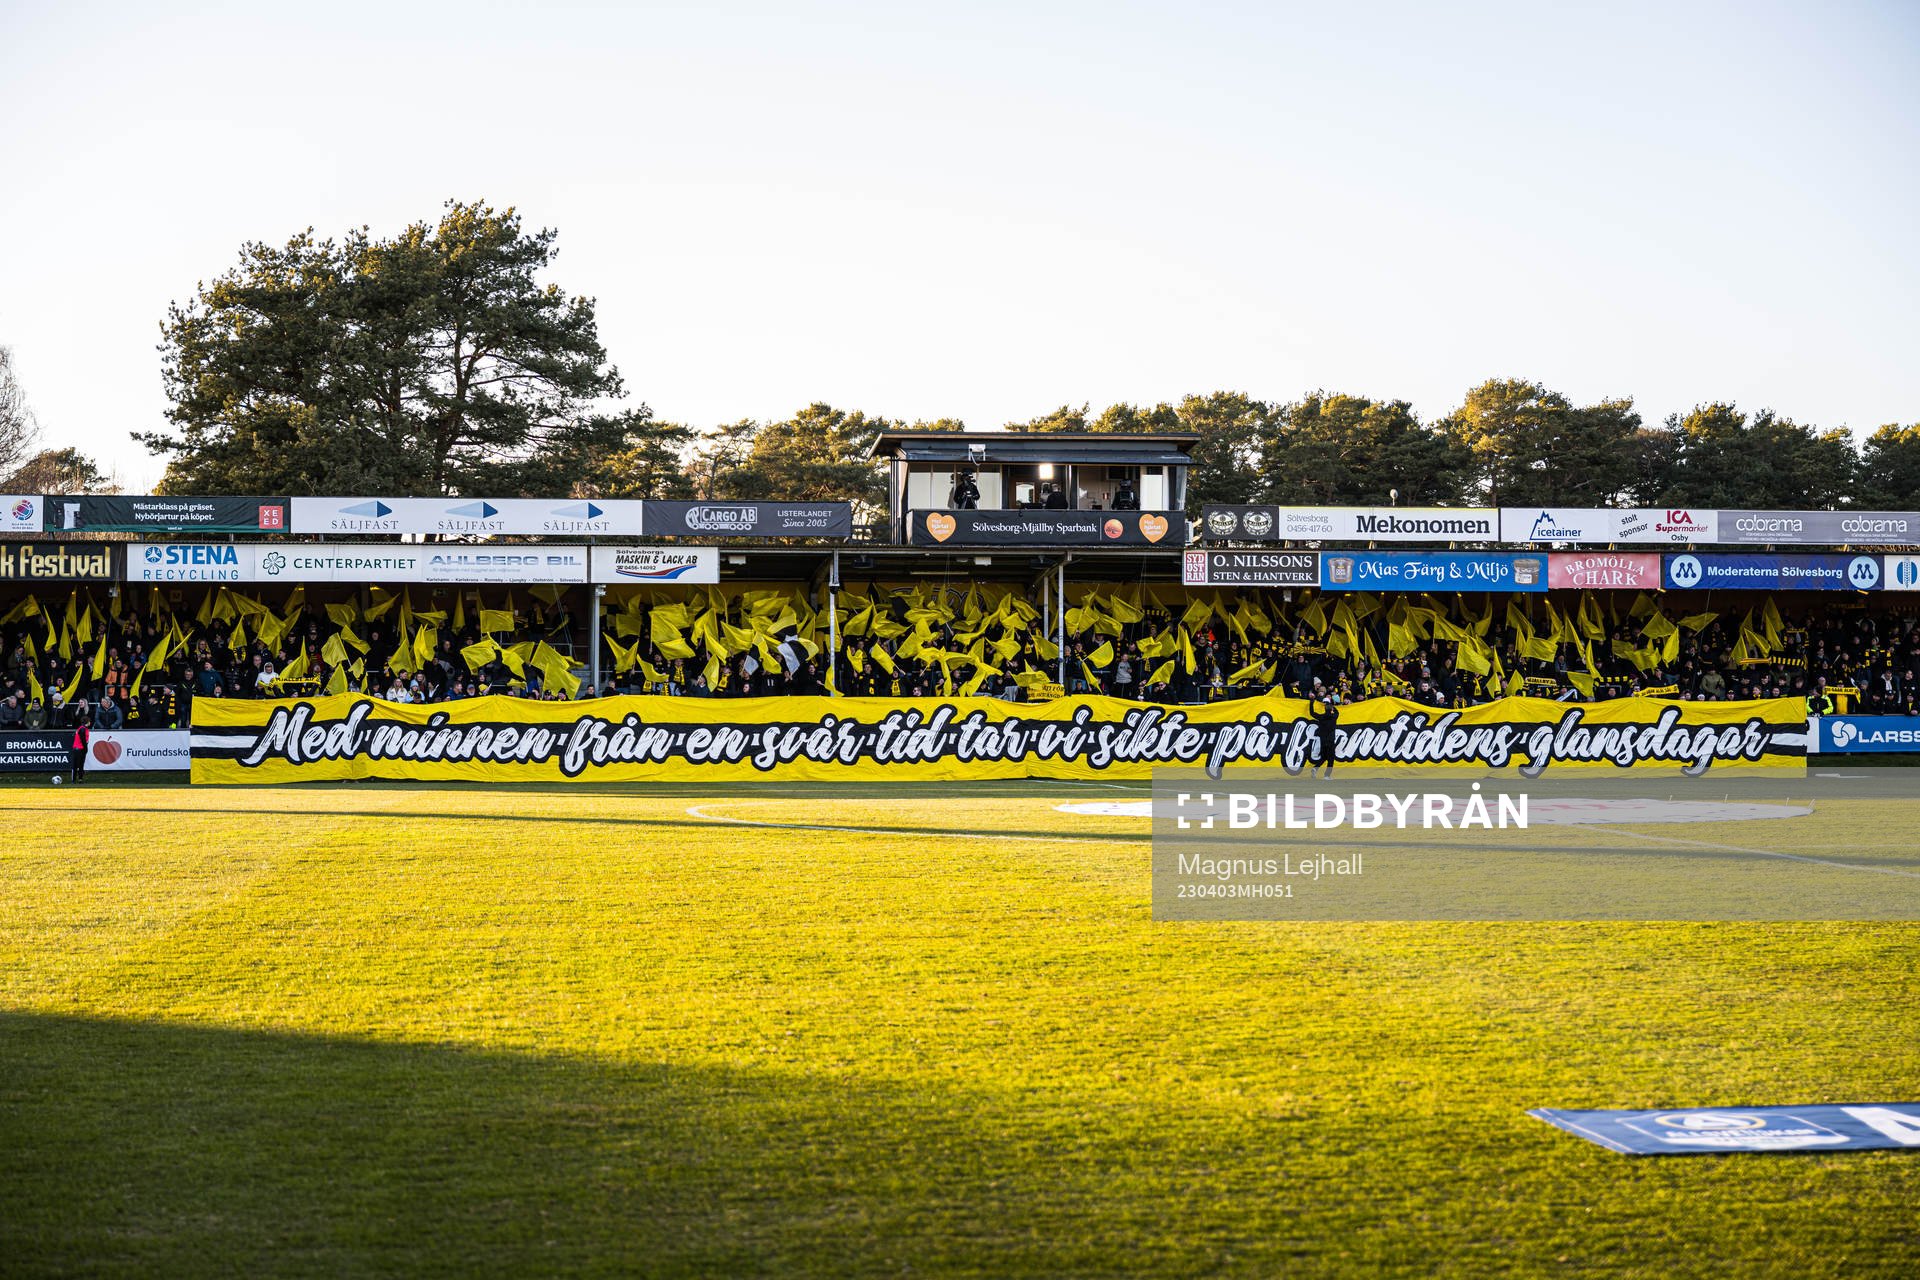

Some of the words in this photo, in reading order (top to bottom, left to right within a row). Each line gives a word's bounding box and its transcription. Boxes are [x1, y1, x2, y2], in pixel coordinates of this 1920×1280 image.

[133, 503, 178, 511] Mästarklass
[178, 503, 188, 512] på
[190, 503, 215, 512] gräset.
[135, 512, 179, 521] Nybörjartur
[180, 513, 190, 521] på
[190, 513, 214, 521] köpet.
[740, 509, 756, 522] AB
[1621, 513, 1638, 525] stolt
[1666, 510, 1692, 524] ICA
[331, 518, 399, 531] SÄLJFAST
[438, 520, 505, 532] SÄLJFAST
[544, 520, 610, 532] SÄLJFAST
[782, 519, 805, 527] Since
[806, 519, 827, 527] 2005
[972, 522, 1055, 534] Sölvesborg-Mjällby
[1056, 523, 1096, 534] Sparbank
[1287, 525, 1321, 533] 0456-417
[1322, 525, 1332, 533] 60
[1356, 515, 1490, 534] Mekonomen
[1655, 523, 1708, 533] Supermarket
[1736, 514, 1802, 532] colorama
[1841, 515, 1907, 533] colorama
[1537, 527, 1582, 537] icetainer
[1619, 522, 1648, 539] sponsor
[1671, 534, 1689, 542] Osby
[166, 546, 238, 564] STENA
[429, 556, 539, 565] AHLBERG
[547, 556, 581, 565] BIL
[615, 555, 650, 564] MASKIN
[652, 555, 660, 564] &
[662, 555, 684, 564] LACK
[686, 556, 697, 564] AB
[1187, 554, 1204, 562] SYD
[1213, 554, 1229, 567] O.
[1234, 555, 1312, 568] NILSSONS
[293, 559, 416, 569] CENTERPARTIET
[1566, 555, 1644, 576] BROMÖLLA
[144, 570, 239, 580] RECYCLING
[1213, 572, 1240, 580] STEN
[1242, 572, 1251, 580] &
[1254, 572, 1313, 581] HANTVERK
[1360, 561, 1399, 579] Mias
[1404, 561, 1445, 582] Färg
[1450, 562, 1462, 579] &
[1708, 566, 1779, 576] Moderaterna
[1782, 566, 1843, 579] Sölvesborg
[1573, 571, 1638, 586] CHARK
[6, 740, 62, 749] BROMÖLLA
[241, 702, 372, 764] Med
[371, 714, 556, 760] minnen
[564, 716, 674, 773] från
[685, 726, 748, 760] en
[754, 716, 864, 768] svår
[876, 706, 951, 760] tid
[958, 713, 1030, 758] tar
[1038, 708, 1088, 757] vi
[1090, 709, 1208, 766] sikte
[1209, 714, 1282, 777] på
[1521, 710, 1770, 777] glansdagar
[126, 748, 191, 757] Furulundssko
[0, 755, 69, 764] KARLSKRONA
